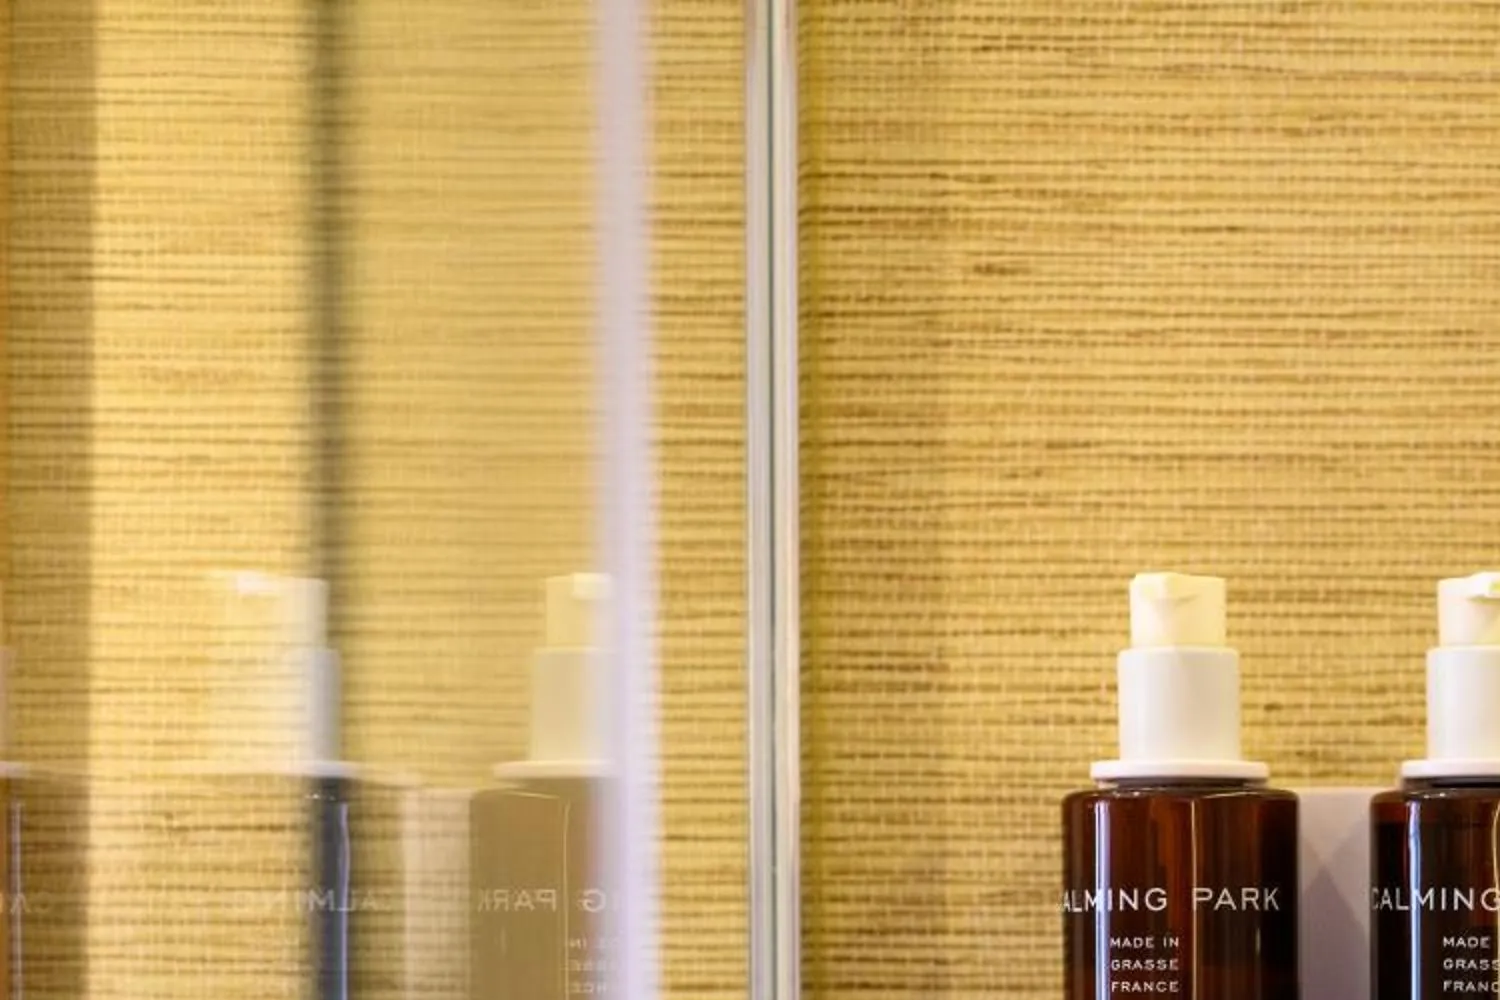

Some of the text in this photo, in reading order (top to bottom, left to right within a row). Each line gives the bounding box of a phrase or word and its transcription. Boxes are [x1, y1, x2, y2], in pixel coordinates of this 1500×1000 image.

[1057, 887, 1281, 912] ALMING PARK
[1109, 936, 1180, 949] MADE IN
[1443, 936, 1491, 949] MADE
[1111, 958, 1179, 971] GRASSE
[1111, 981, 1180, 993] FRANCE
